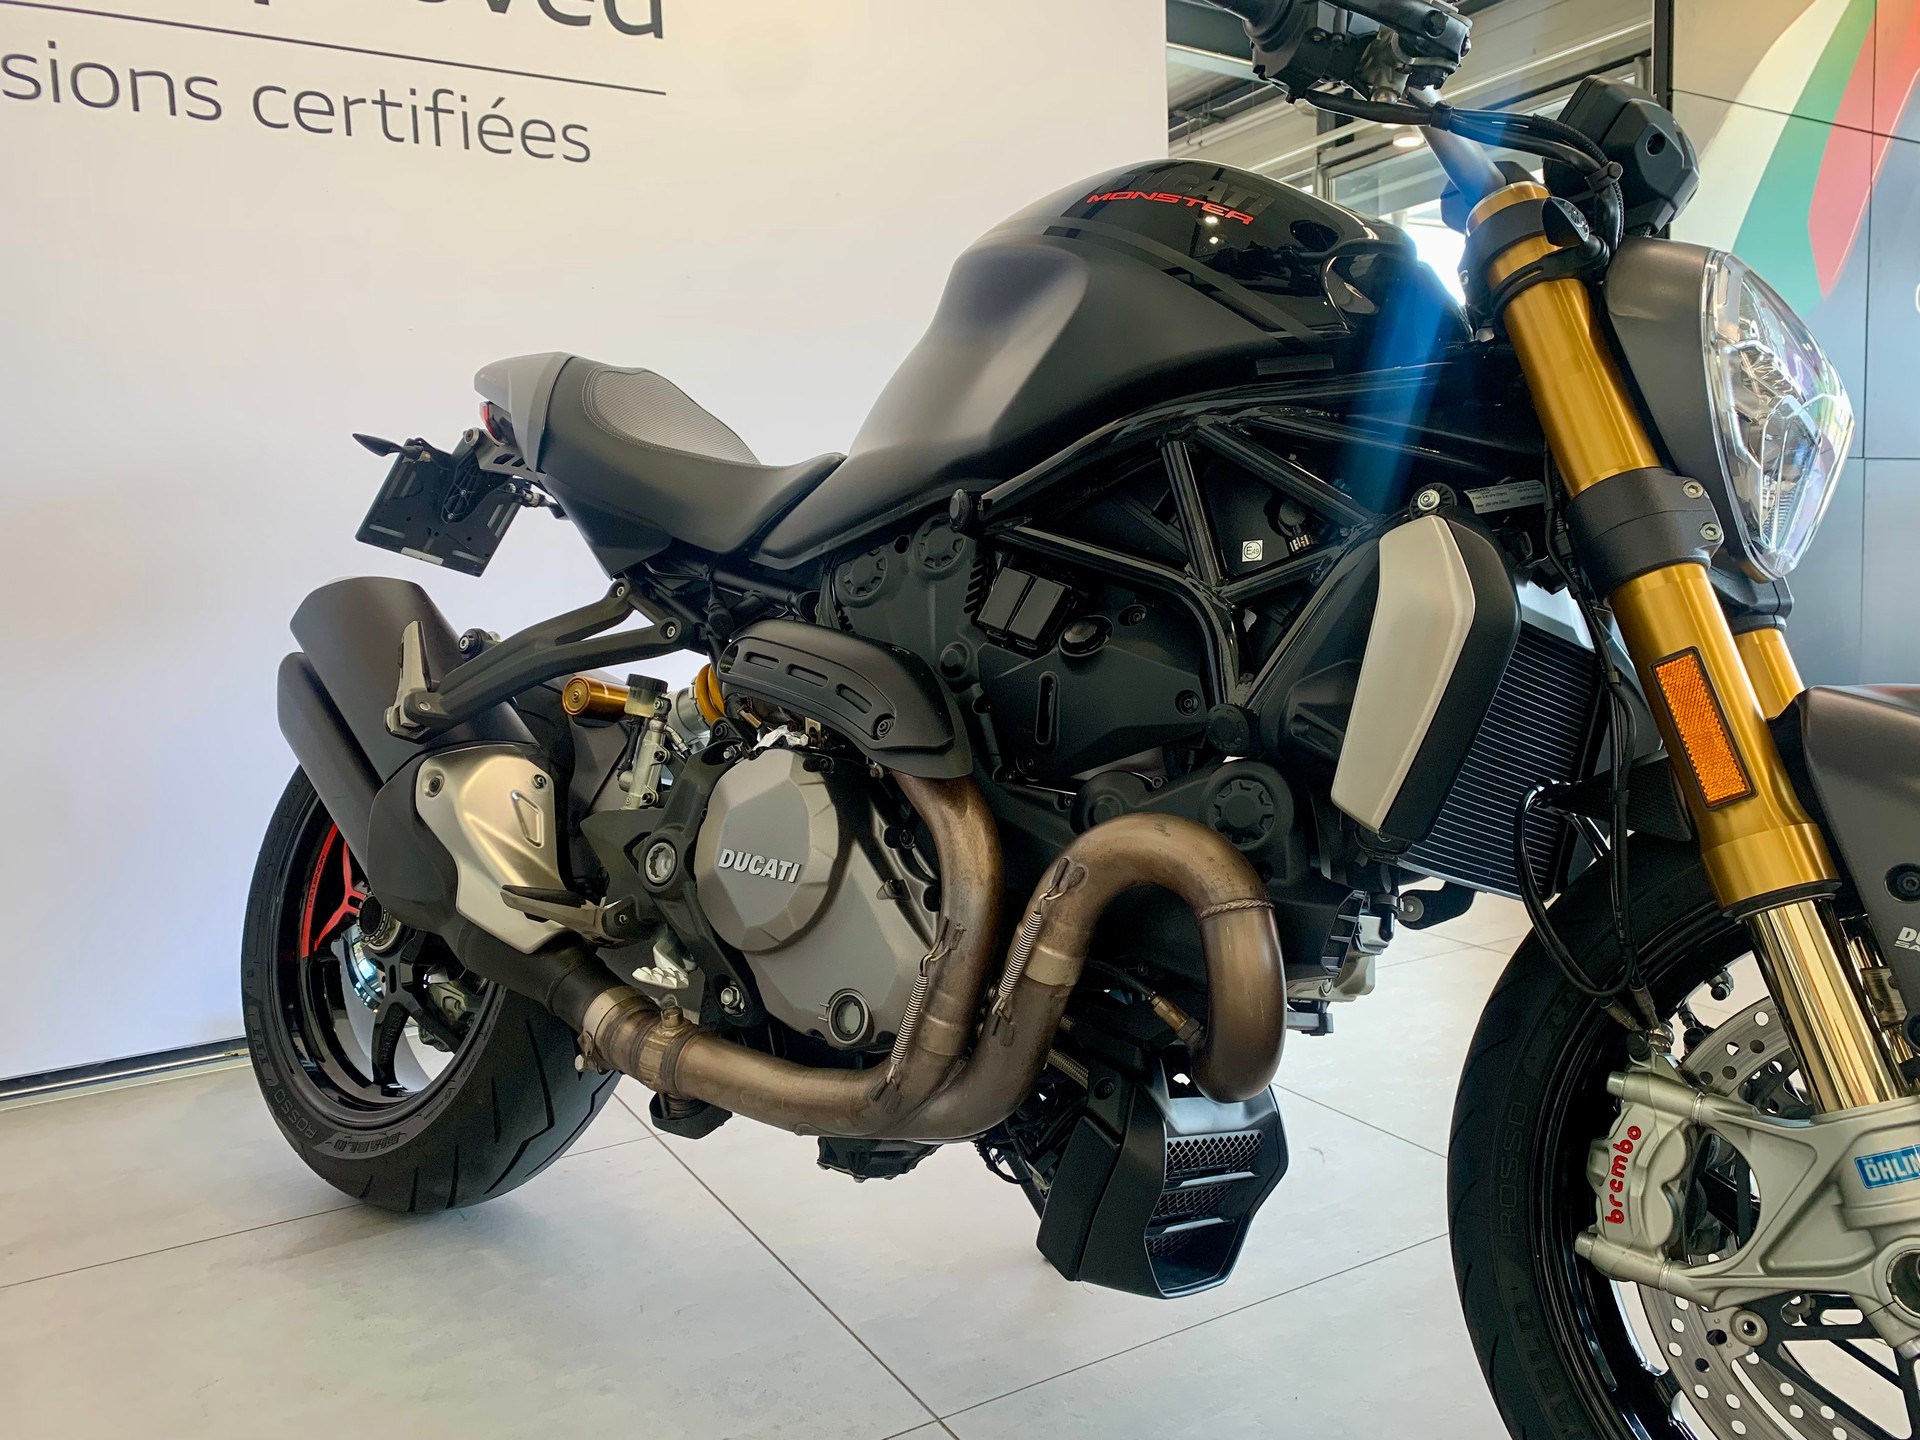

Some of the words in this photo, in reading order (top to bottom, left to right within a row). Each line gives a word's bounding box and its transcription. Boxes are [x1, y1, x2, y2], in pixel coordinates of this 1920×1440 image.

[1, 40, 222, 121] sions
[252, 84, 591, 163] certifiées
[1086, 190, 1254, 226] MONSTER
[1100, 171, 1276, 217] DUCATI
[718, 849, 800, 883] DUCATI
[274, 1088, 319, 1139] ROSSO
[334, 1133, 400, 1153] DIABLO
[1500, 1101, 1529, 1237] ROSSO
[1605, 1126, 1642, 1224] brembo
